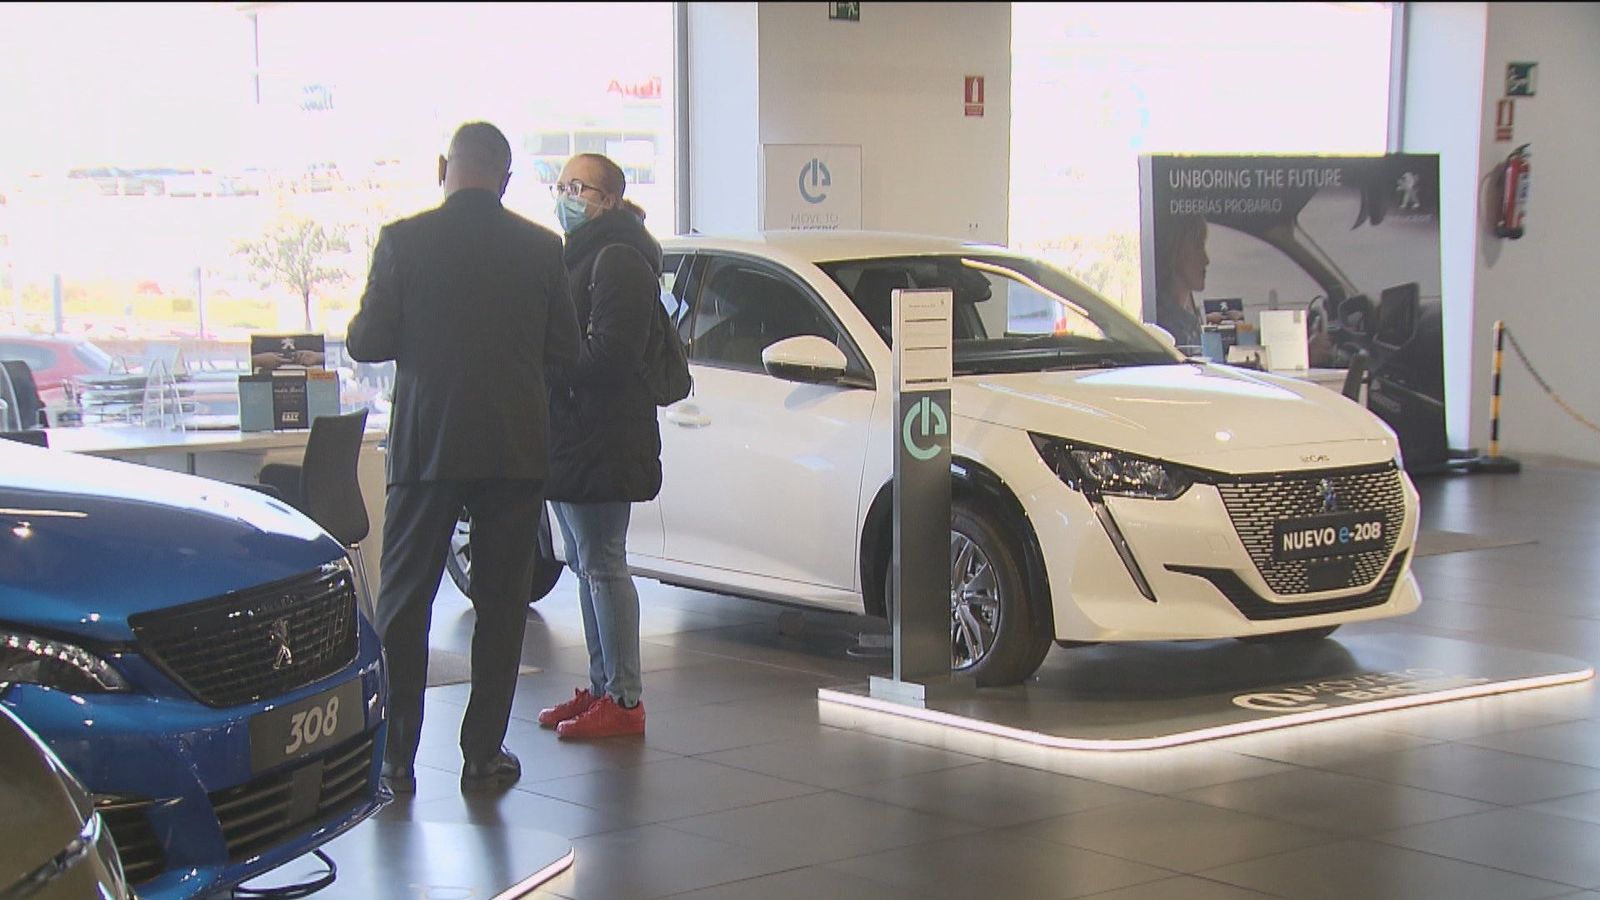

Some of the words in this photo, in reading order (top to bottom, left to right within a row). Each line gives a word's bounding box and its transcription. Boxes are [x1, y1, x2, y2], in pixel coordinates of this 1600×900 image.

[606, 76, 662, 98] Audi
[1169, 169, 1250, 188] UNBORING
[1255, 169, 1284, 187] THE
[1288, 168, 1342, 187] FUTURE
[1170, 197, 1222, 214] DEBERÍAS
[1225, 198, 1282, 213] PROBARLO
[790, 213, 821, 225] MOVE
[823, 213, 840, 225] TO
[1283, 527, 1335, 551] NUEVO
[1339, 522, 1382, 543] e-208
[285, 696, 339, 755] 308
